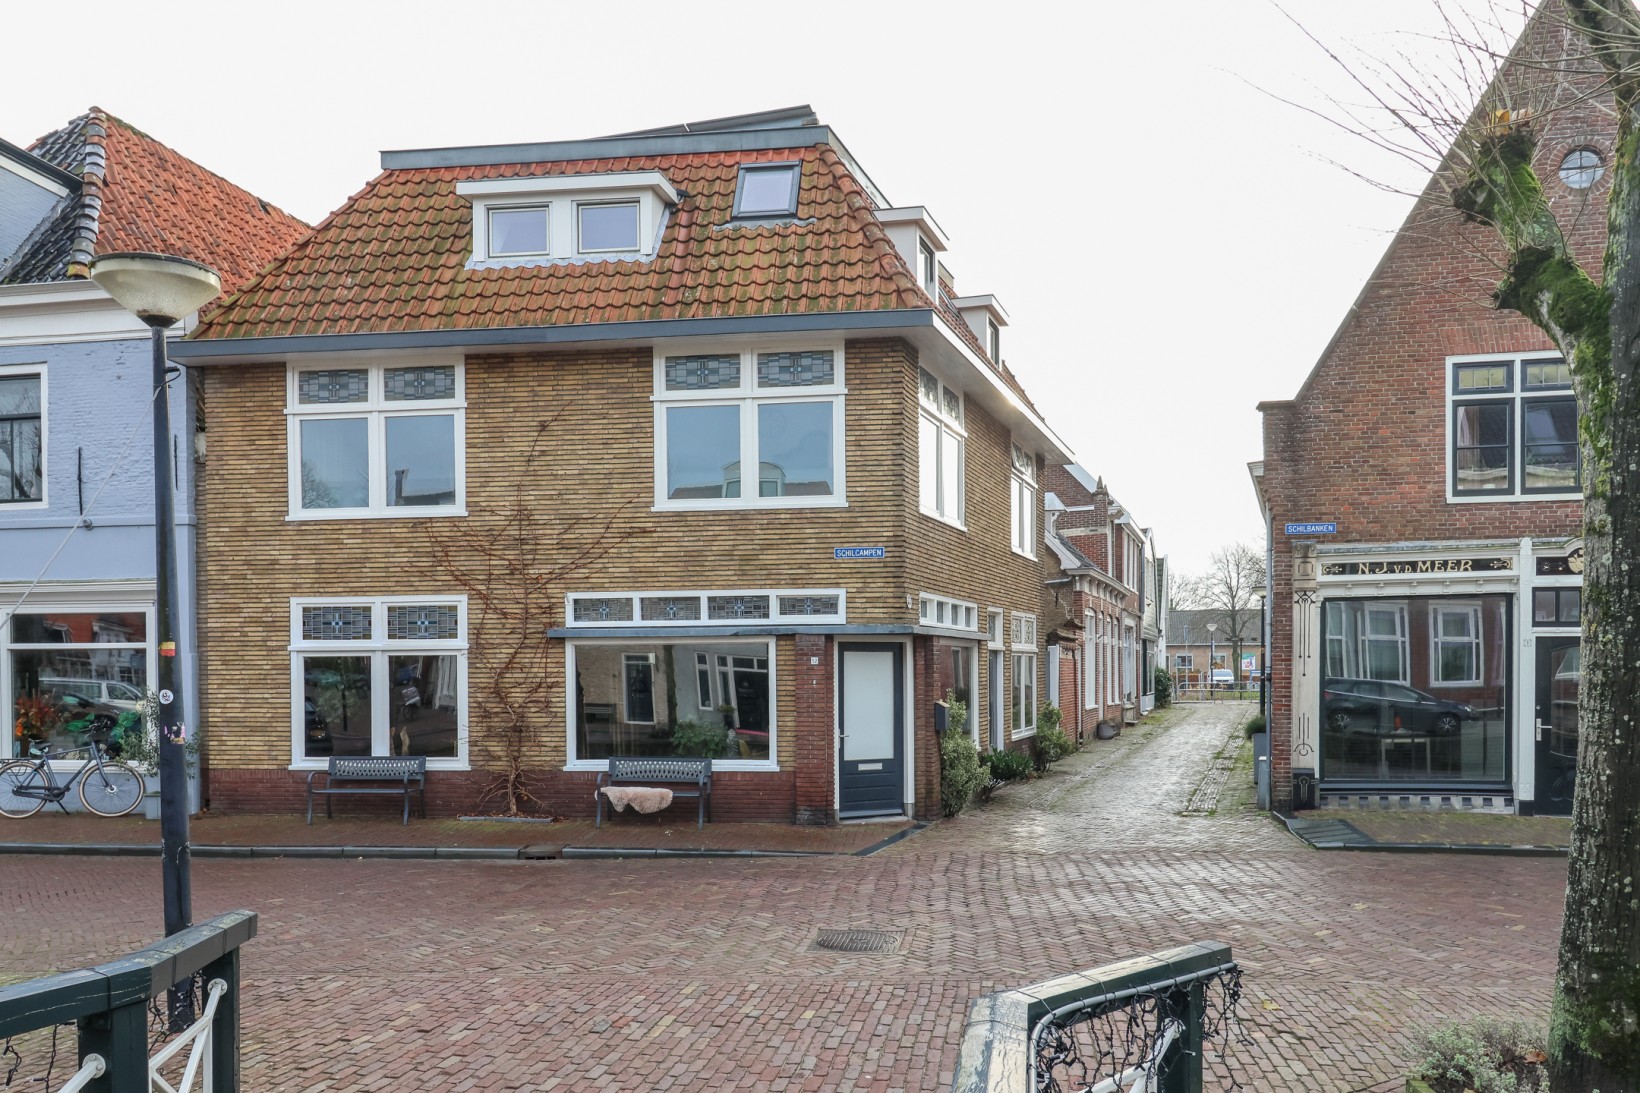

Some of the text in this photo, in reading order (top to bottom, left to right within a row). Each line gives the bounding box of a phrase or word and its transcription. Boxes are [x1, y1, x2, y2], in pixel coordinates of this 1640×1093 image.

[1288, 524, 1333, 532] SCHILBANKEN
[837, 548, 882, 556] SCHILCAMPEN
[1416, 559, 1472, 572] MEER
